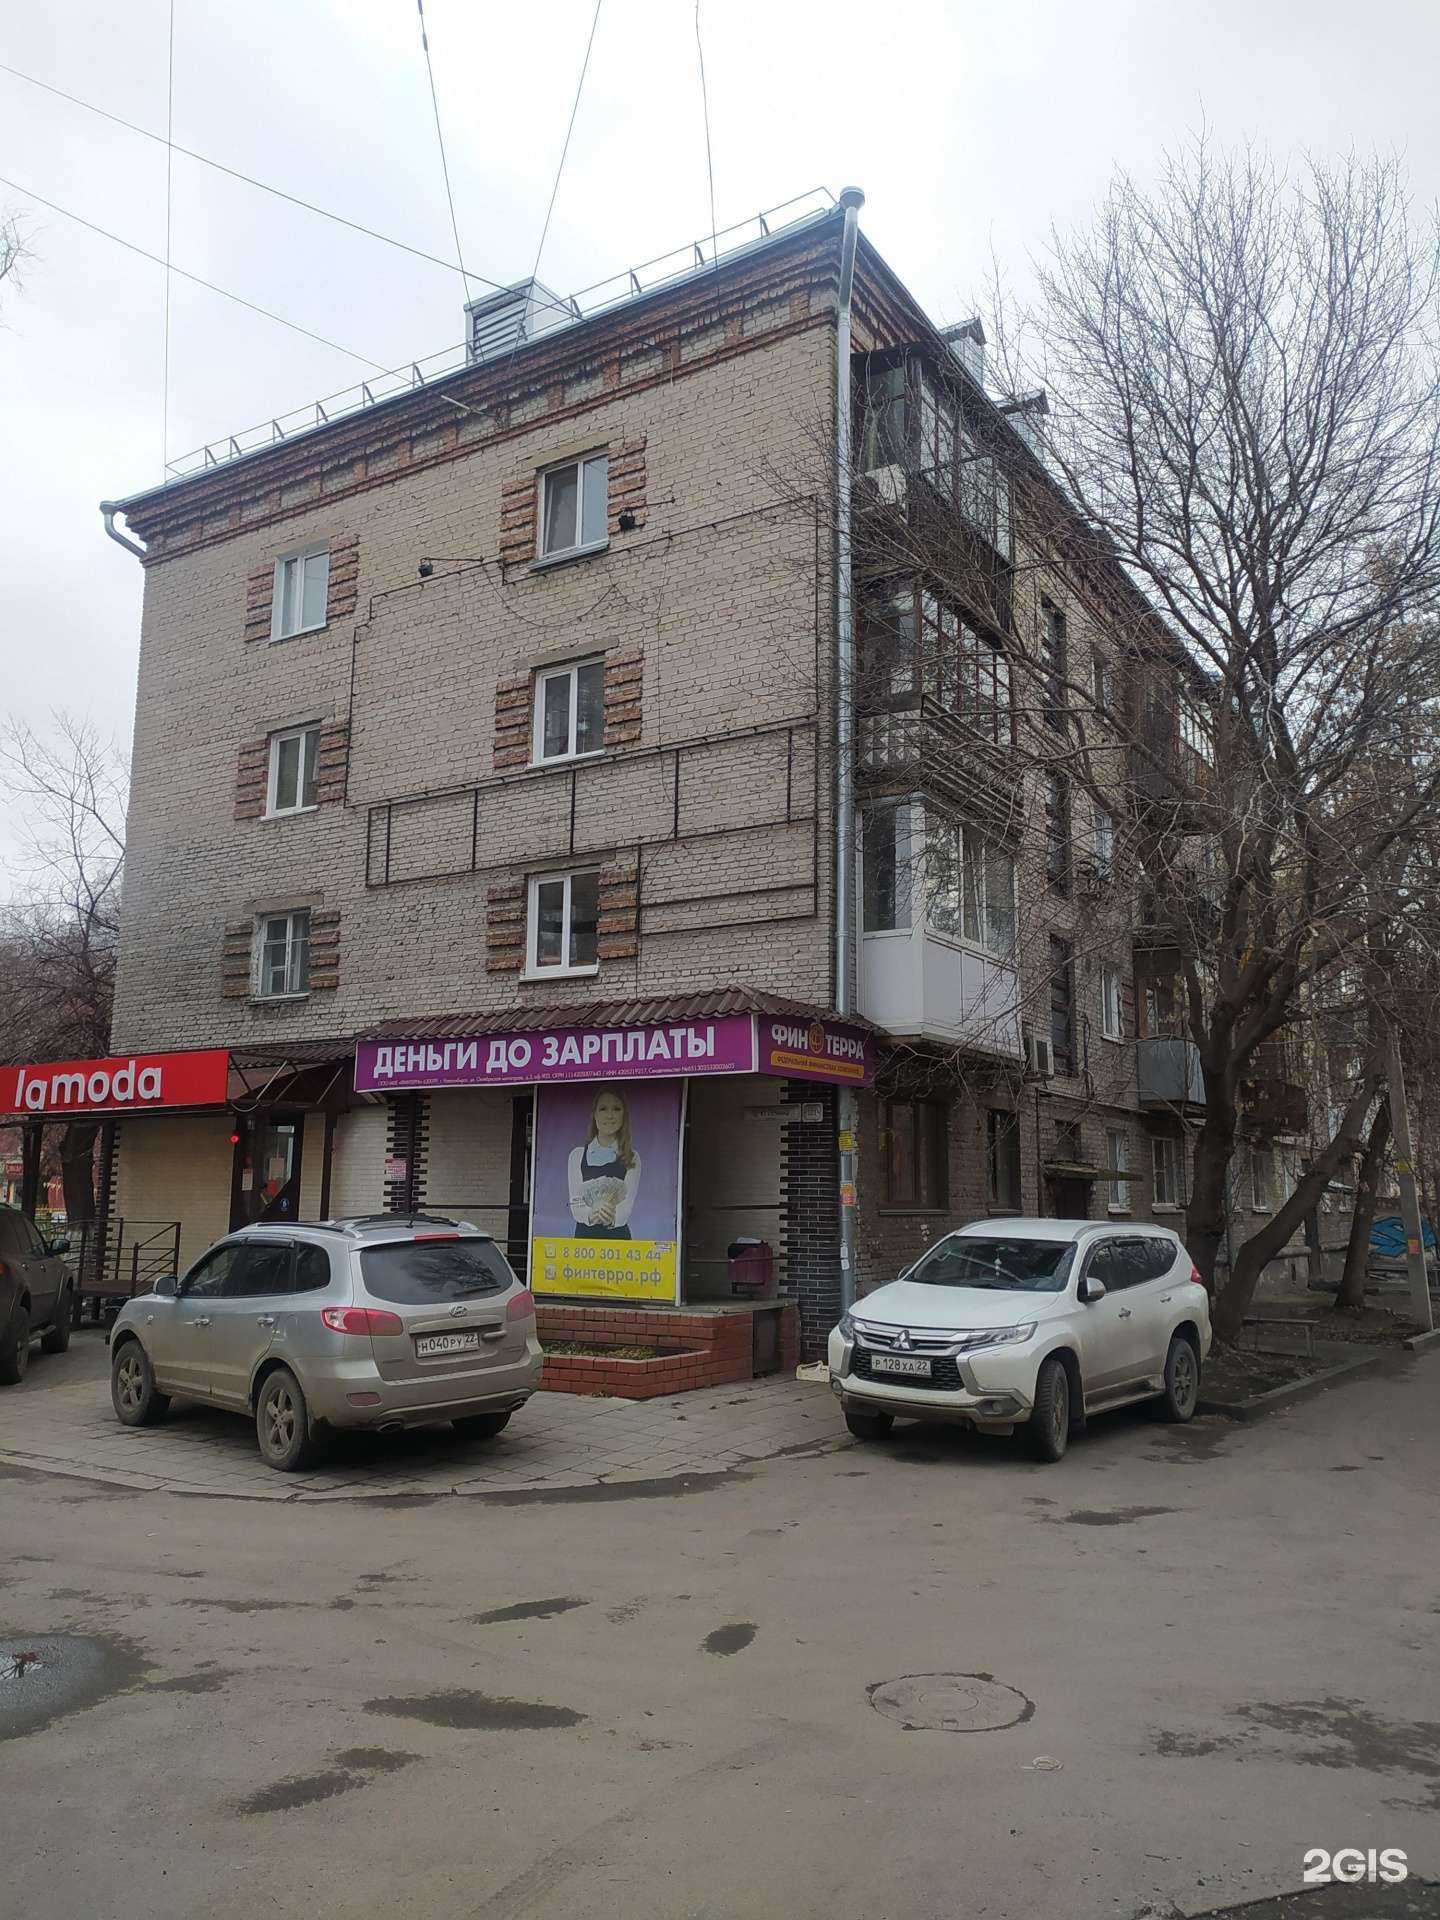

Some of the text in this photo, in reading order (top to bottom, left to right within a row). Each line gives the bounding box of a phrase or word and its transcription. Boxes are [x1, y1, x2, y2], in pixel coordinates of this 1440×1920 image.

[373, 1041, 477, 1078] ДЕНЬГИ
[486, 1035, 532, 1074] ДО
[542, 1026, 715, 1067] ЗАРПЛАТЫ
[14, 1060, 163, 1111] lamoda
[562, 1247, 569, 1258] 8
[574, 1247, 595, 1259] 800
[600, 1249, 621, 1261] 301
[626, 1249, 641, 1261] 43
[562, 1264, 661, 1286] финтерра.рф
